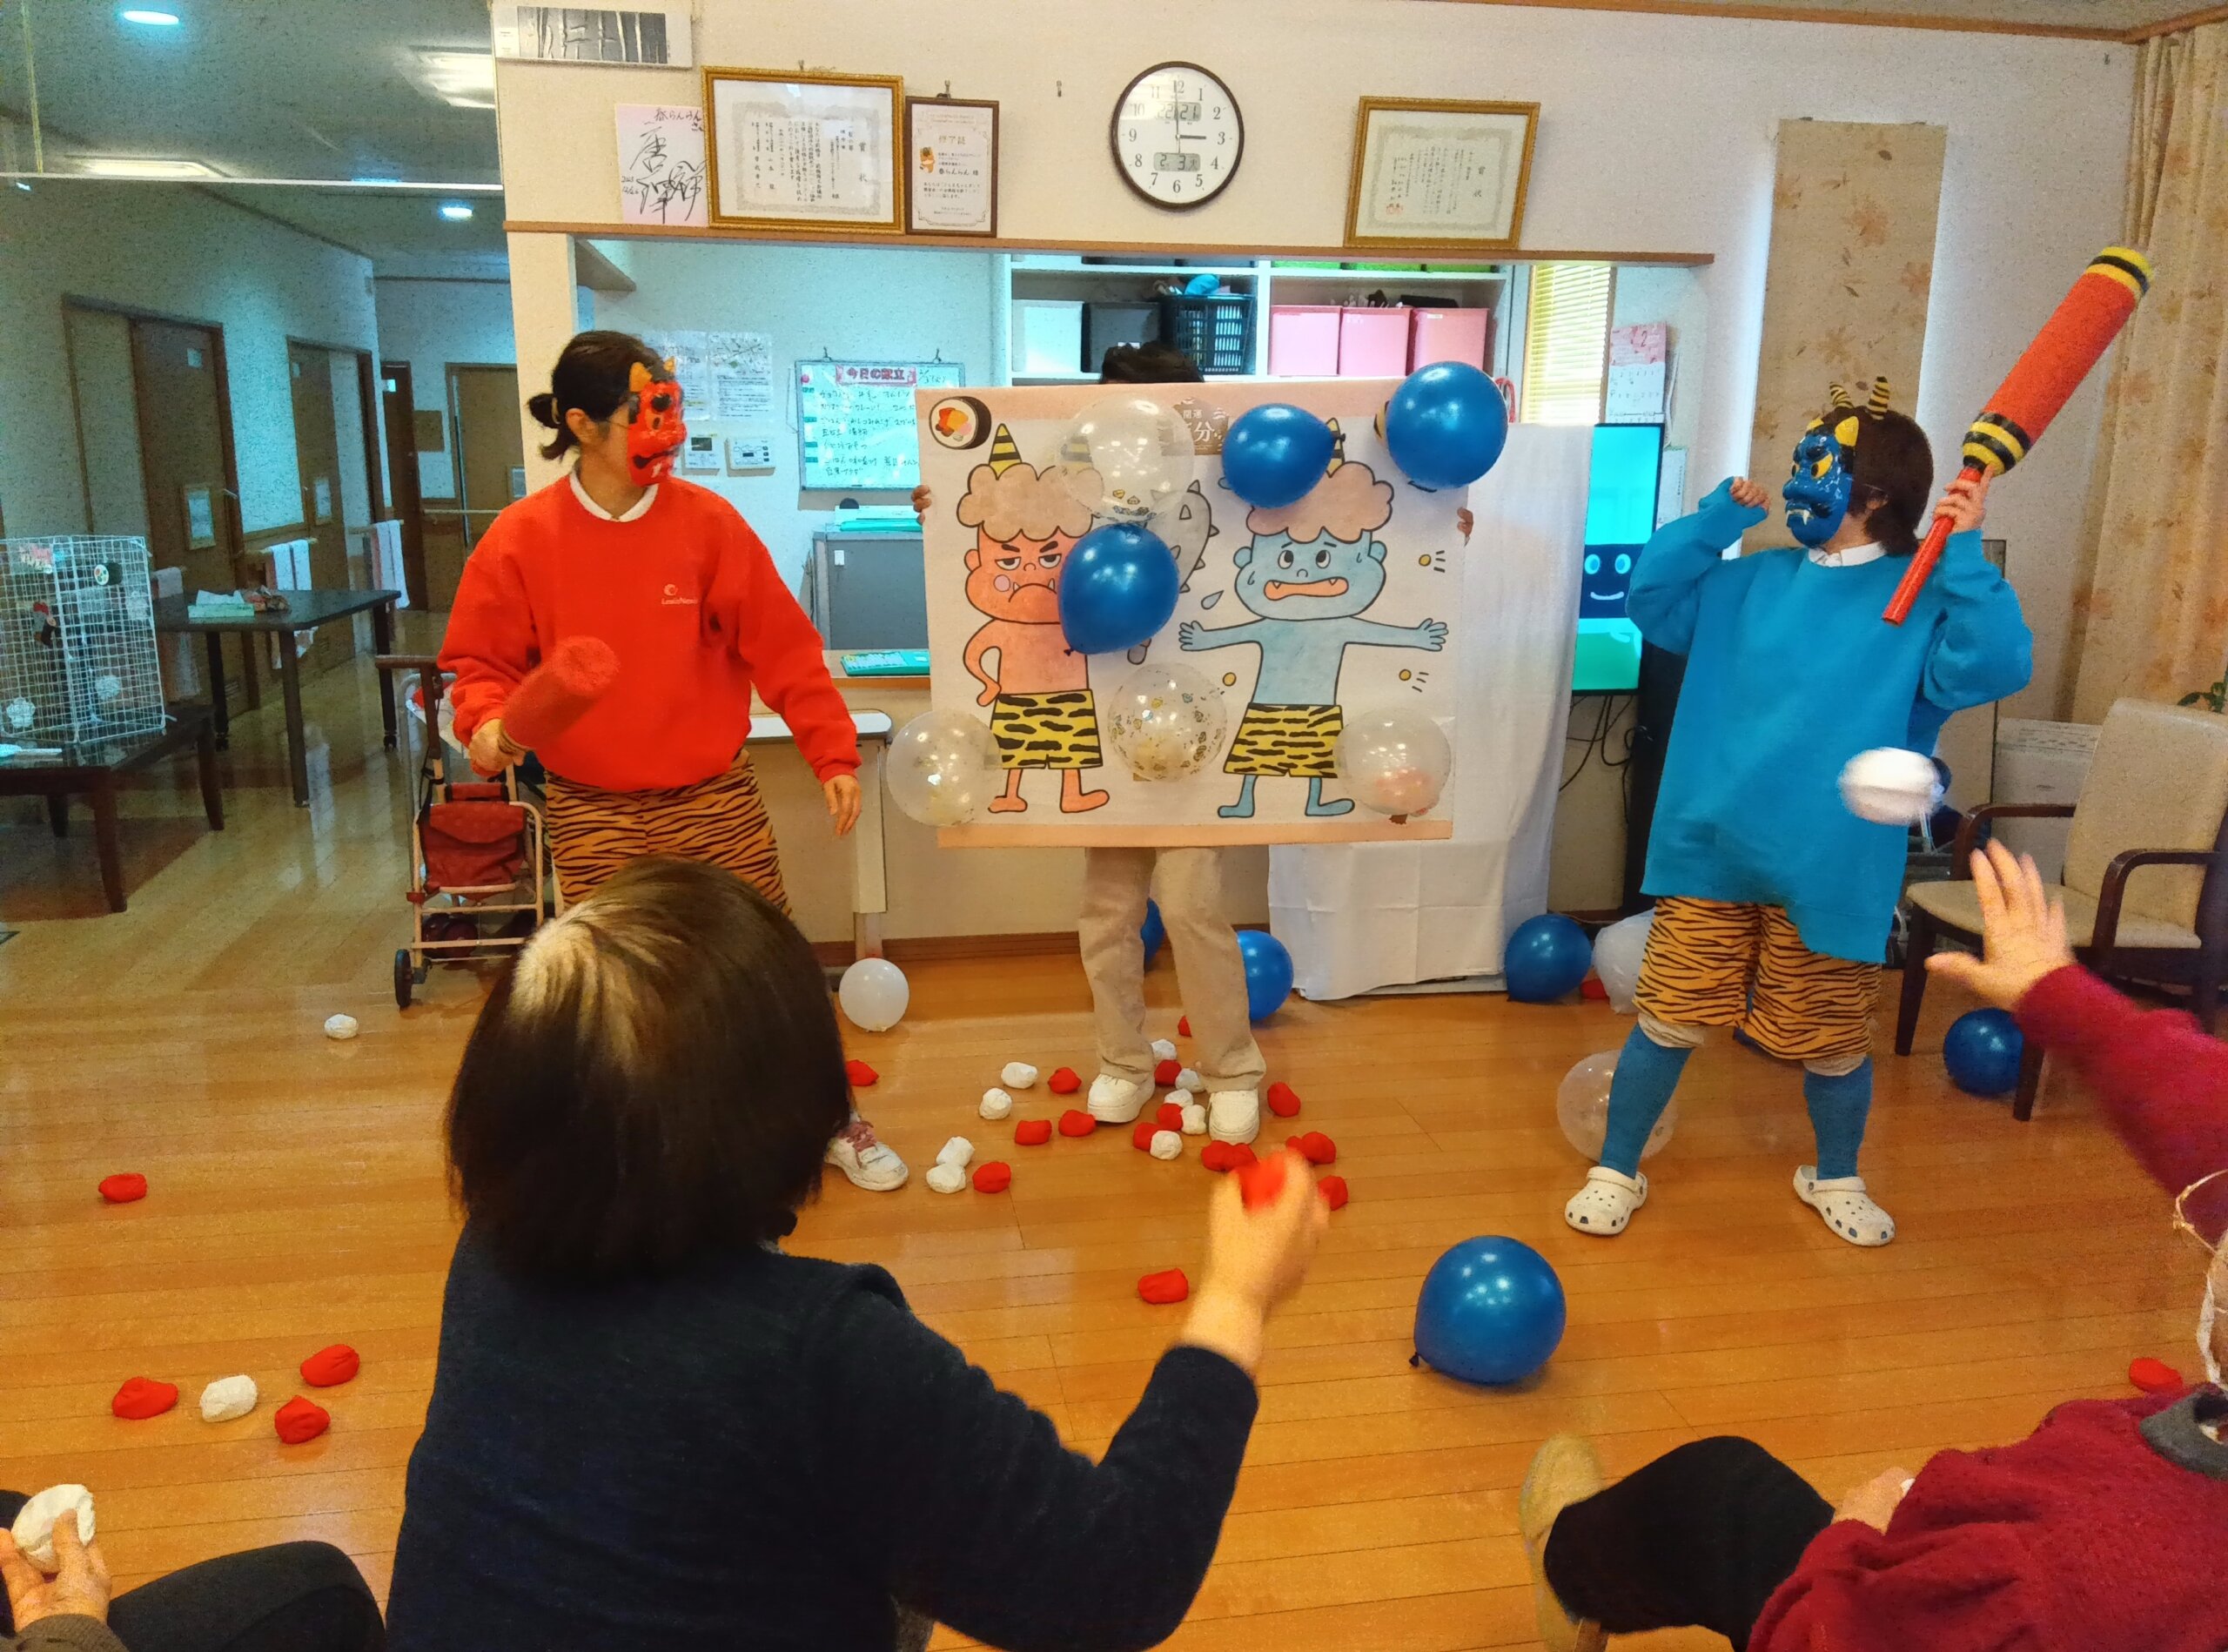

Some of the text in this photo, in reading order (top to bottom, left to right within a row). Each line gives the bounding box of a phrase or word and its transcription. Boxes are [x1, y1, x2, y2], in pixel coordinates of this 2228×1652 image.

[1198, 88, 1204, 101] 1
[1133, 104, 1145, 116] 10
[1212, 106, 1221, 120] 2
[1128, 128, 1137, 142] 9
[1217, 131, 1225, 145] 3
[1134, 153, 1143, 167] 8
[1210, 156, 1219, 170] 4
[1150, 172, 1159, 186] 7
[1172, 179, 1182, 193] 6
[1195, 174, 1204, 188] 5
[1640, 331, 1648, 348] 2
